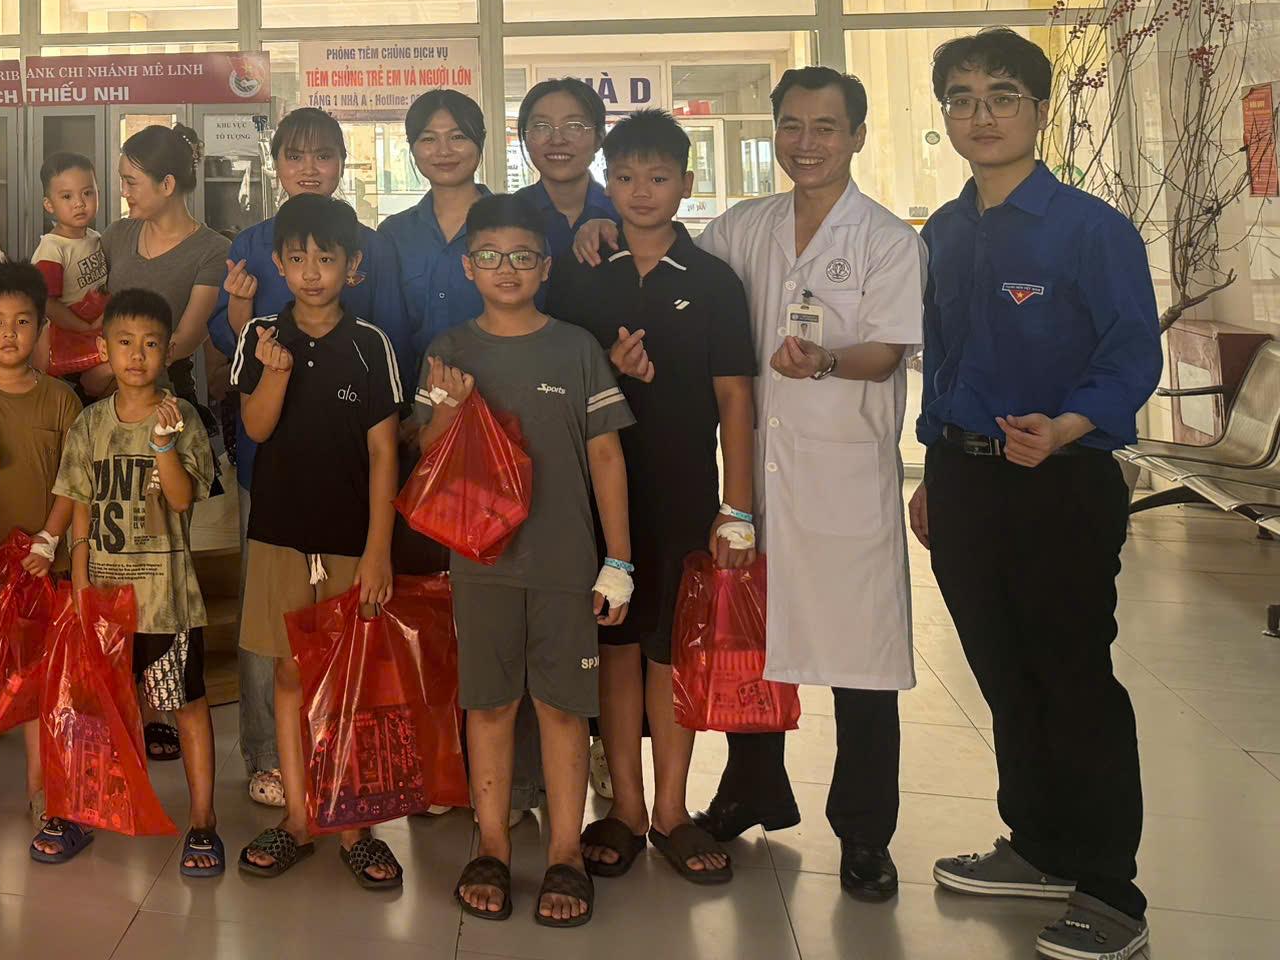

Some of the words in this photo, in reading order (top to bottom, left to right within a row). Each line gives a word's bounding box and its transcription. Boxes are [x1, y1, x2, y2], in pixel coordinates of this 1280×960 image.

[326, 46, 356, 60] PHÒNG
[357, 45, 379, 60] TIÊM
[381, 43, 411, 60] CHỦNG
[413, 46, 434, 61] DỊCH
[436, 46, 448, 61] VỤ
[58, 65, 84, 78] CHI
[87, 62, 139, 78] NHÁNH
[142, 62, 165, 77] MÊ
[169, 63, 204, 76] LINH
[306, 68, 329, 87] TIÊM
[331, 65, 364, 87] CHỦNG
[365, 64, 384, 87] TRẺ
[386, 70, 401, 86] EM
[404, 66, 417, 86] VÀ
[420, 65, 449, 86] NGƯỜI
[452, 66, 472, 86] LỚN
[27, 81, 87, 102] THIẾU
[93, 86, 130, 102] NHI
[308, 91, 331, 107] TẦNG
[333, 95, 338, 106] 1
[340, 92, 359, 106] NHÀ
[361, 95, 367, 106] A
[375, 94, 409, 106] Hotline:
[630, 77, 651, 104] D
